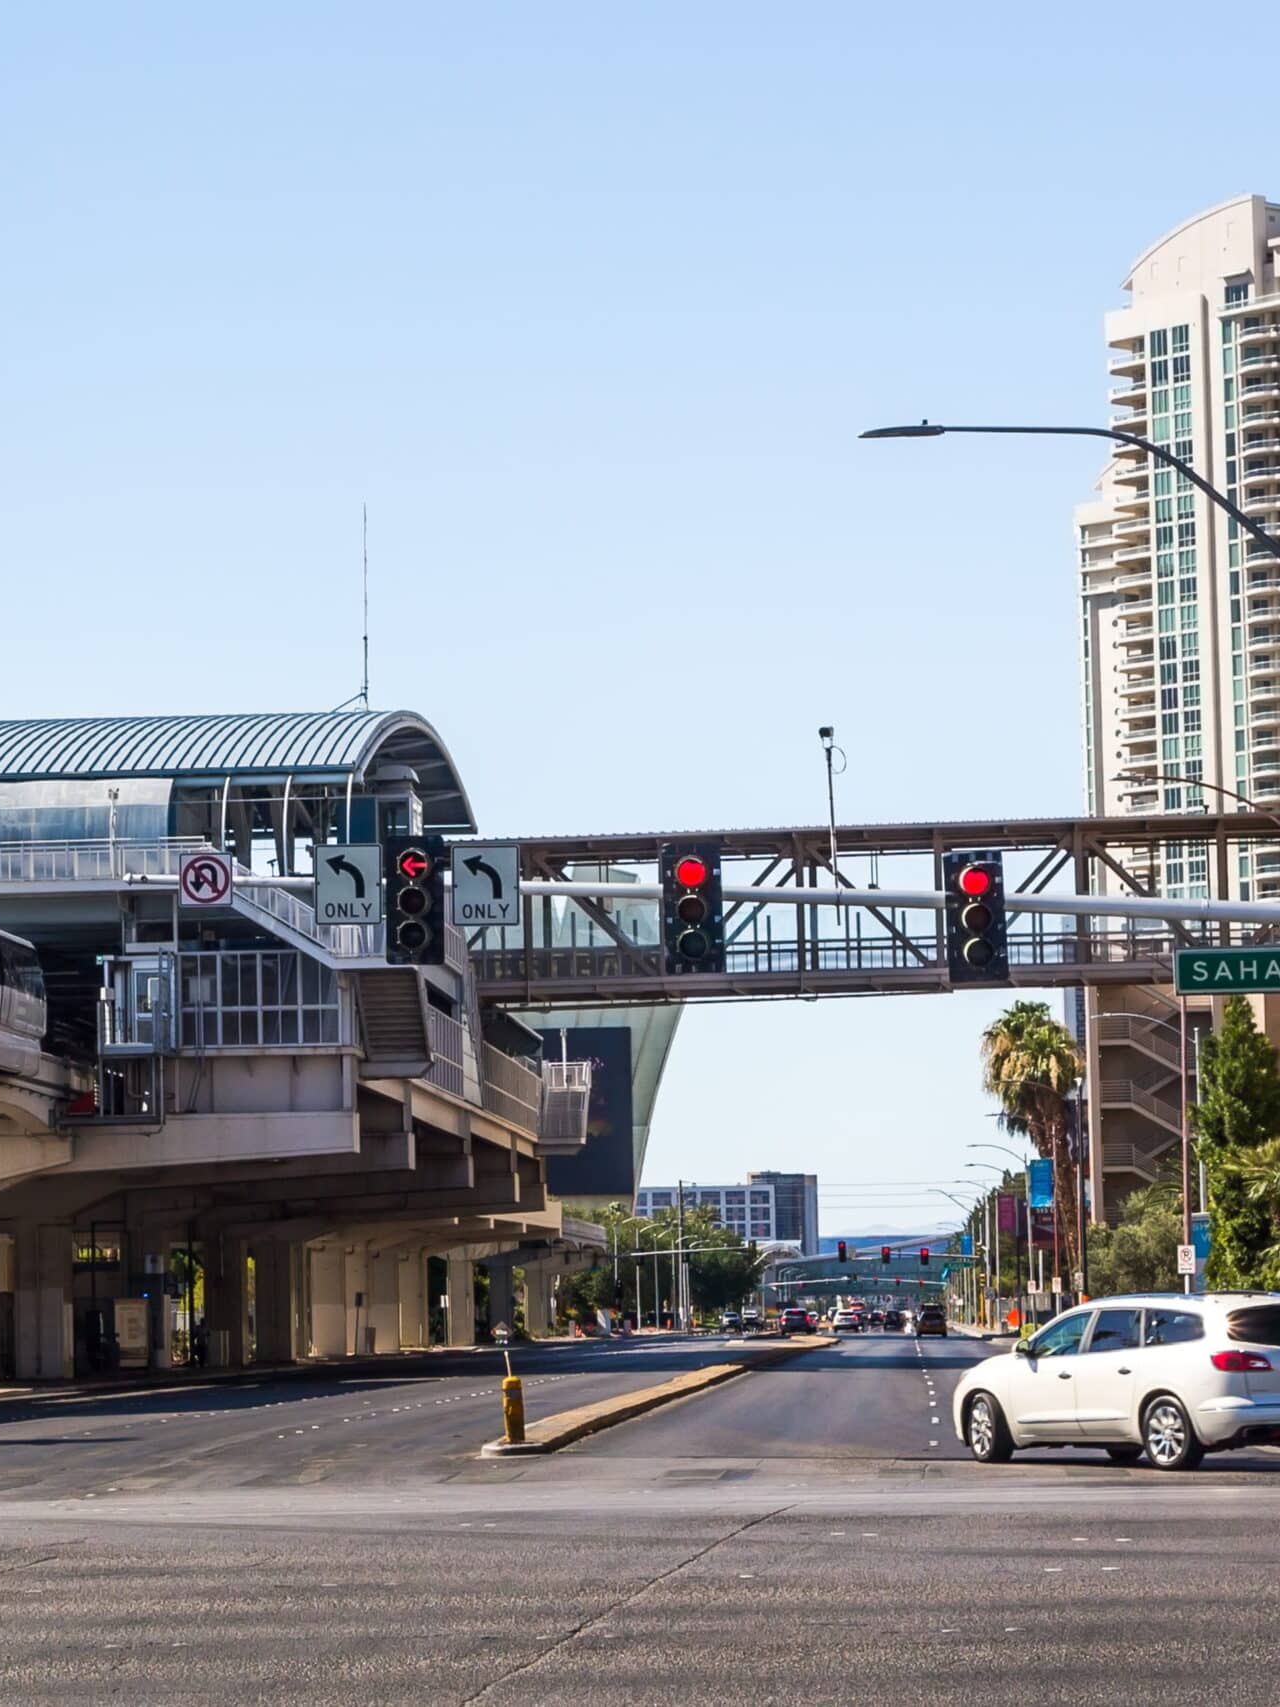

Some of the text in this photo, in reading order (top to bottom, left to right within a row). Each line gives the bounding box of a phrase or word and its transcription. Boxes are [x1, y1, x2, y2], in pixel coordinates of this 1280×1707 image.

[324, 903, 373, 919] ONLY
[462, 903, 510, 919] ONLY
[1192, 959, 1280, 982] SAHA
